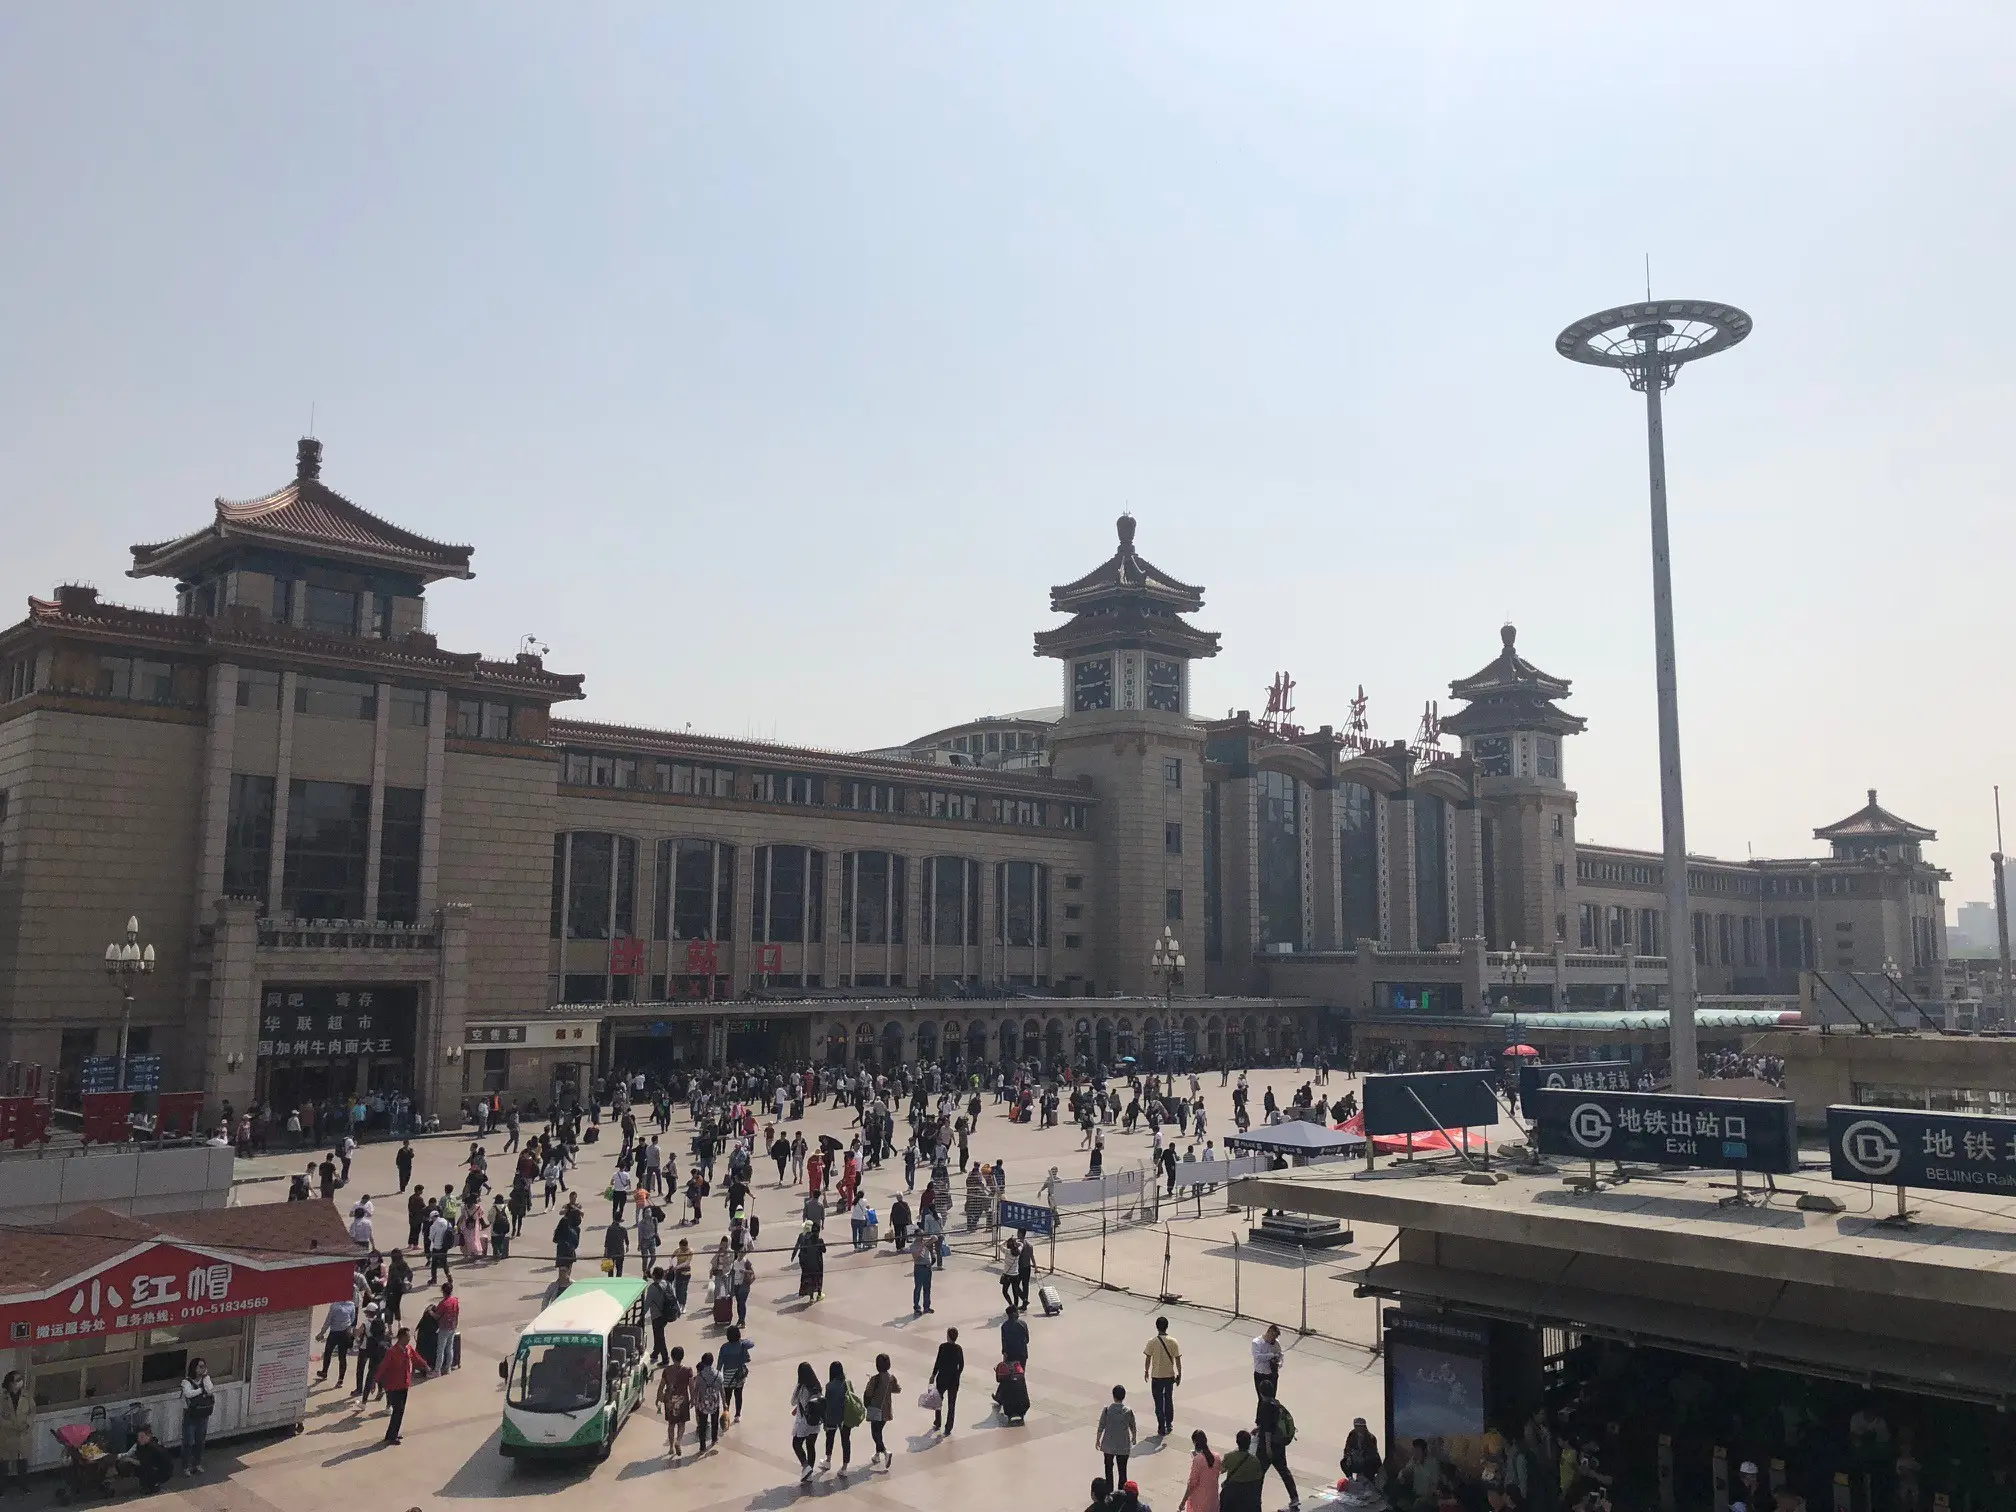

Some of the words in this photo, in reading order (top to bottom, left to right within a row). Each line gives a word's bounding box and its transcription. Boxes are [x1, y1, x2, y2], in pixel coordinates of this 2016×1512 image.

[264, 1014, 373, 1032] 华联超市
[258, 1038, 392, 1056] 国加州牛肉面大王
[1618, 1107, 1747, 1140] 地铁出站口
[1666, 1138, 1698, 1155] Exit
[1926, 1168, 1984, 1184] BEIJING
[69, 1263, 232, 1316] 小红帽
[36, 1320, 105, 1339] 搬运服务处
